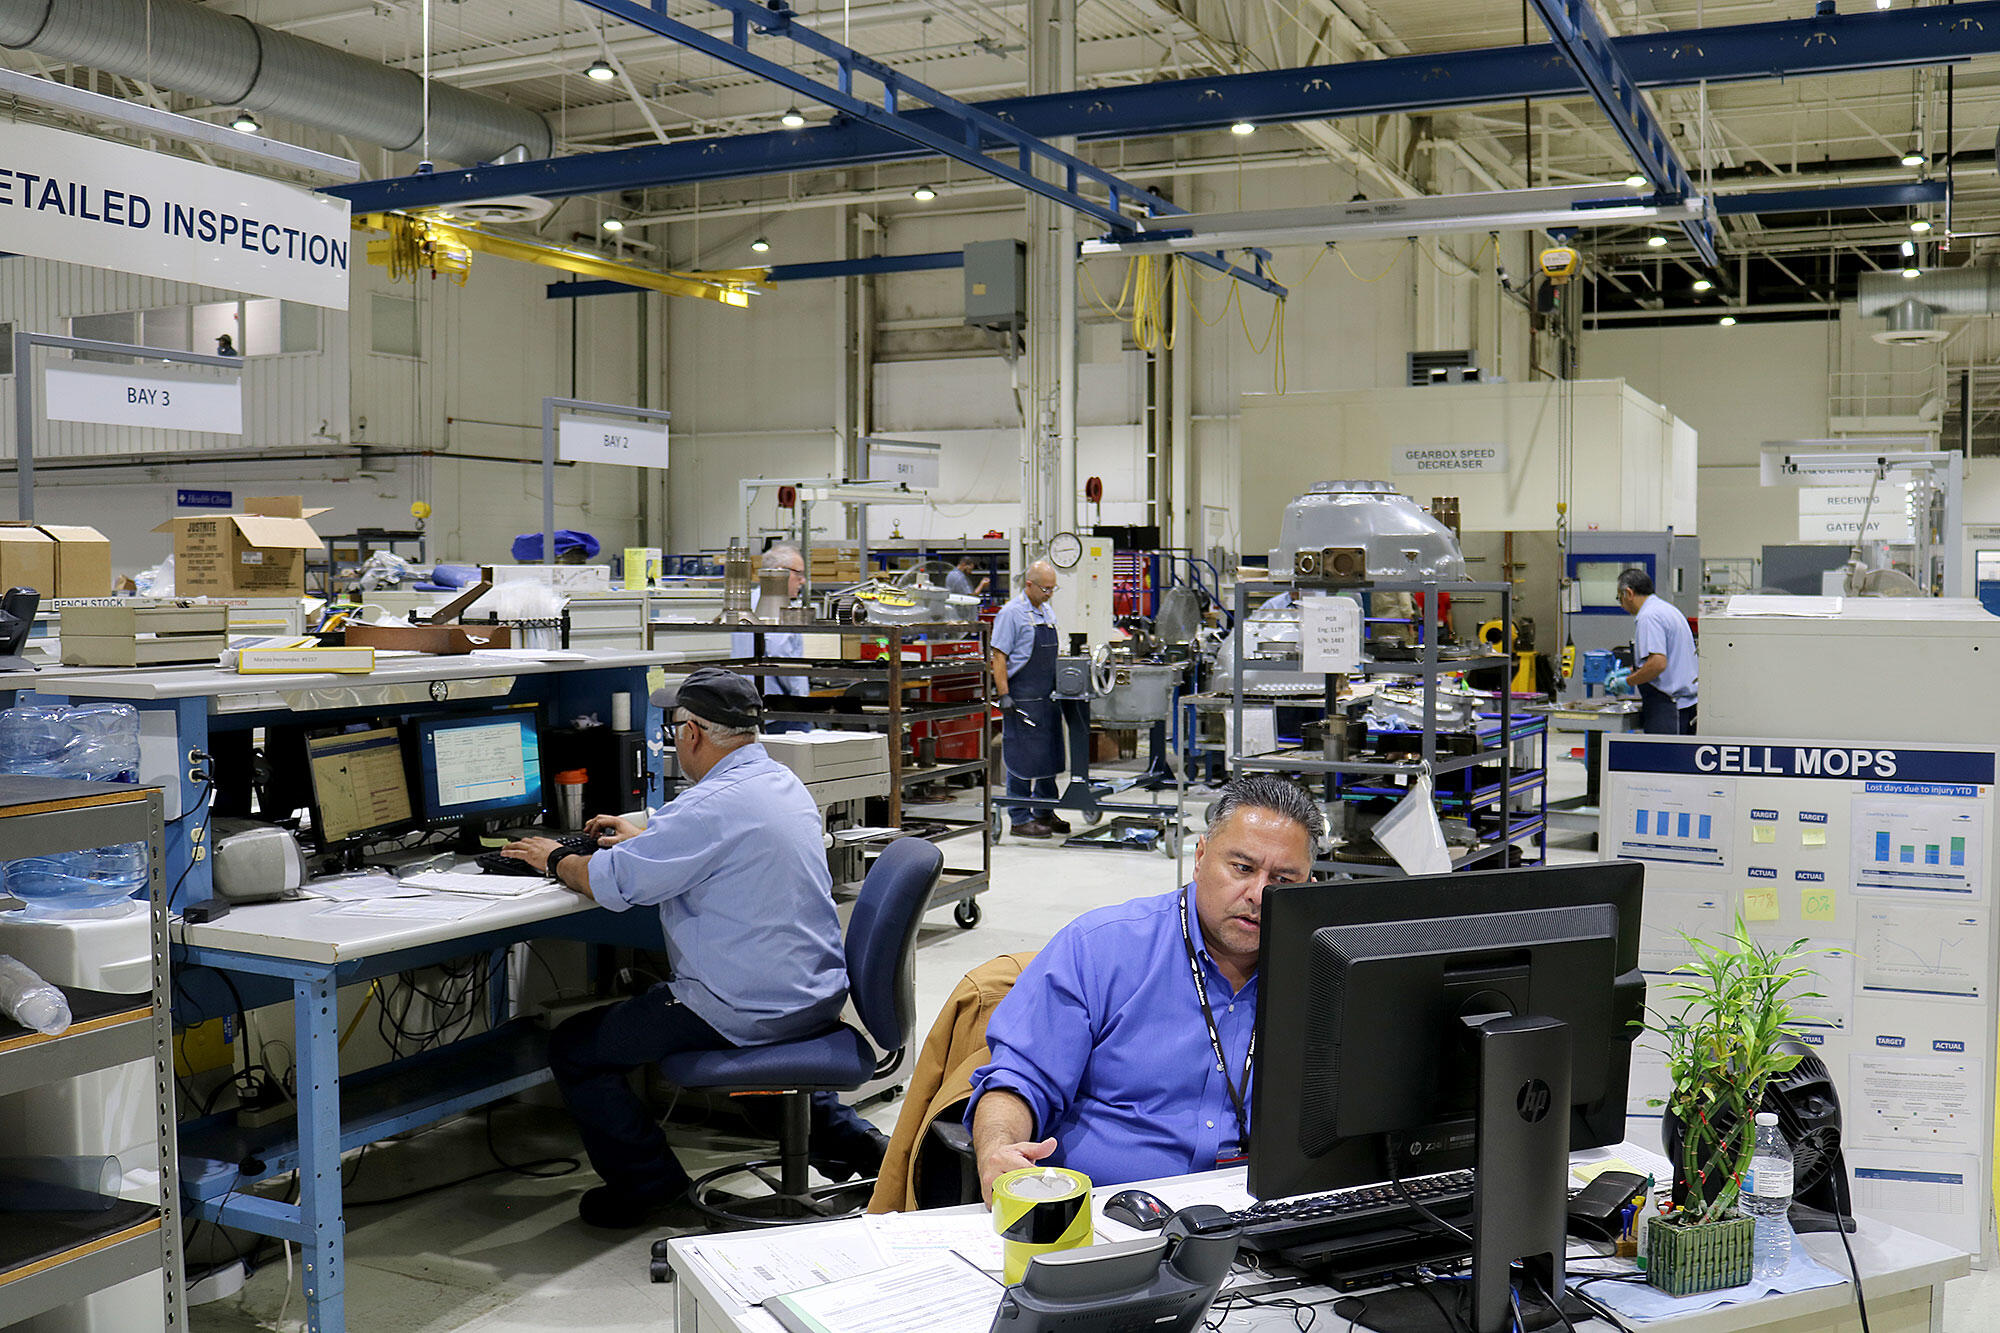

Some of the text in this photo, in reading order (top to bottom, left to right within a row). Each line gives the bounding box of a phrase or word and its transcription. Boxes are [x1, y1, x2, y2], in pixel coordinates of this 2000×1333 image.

[164, 201, 347, 270] INSPECTION
[127, 387, 170, 406] BAY 3
[603, 434, 629, 449] BAY 2
[1406, 449, 1496, 460] GEARBOX SPEED
[1418, 460, 1483, 470] DECREASER
[54, 598, 123, 609] BENCH STOCK
[1694, 745, 1897, 778] CELL MOPS
[1866, 783, 1972, 796] Lost days due to injury YTD
[1752, 811, 1777, 819] TARGET
[1800, 813, 1825, 821] TARGET
[1750, 869, 1775, 877] ACTUAL
[1797, 872, 1823, 880] ACTUAL
[1806, 895, 1830, 914] 0%
[1801, 1036, 1822, 1044] CTUAL
[1877, 1037, 1904, 1046] TARGET
[1935, 1042, 1962, 1051] ACTUAL
[1520, 1079, 1549, 1123] hp
